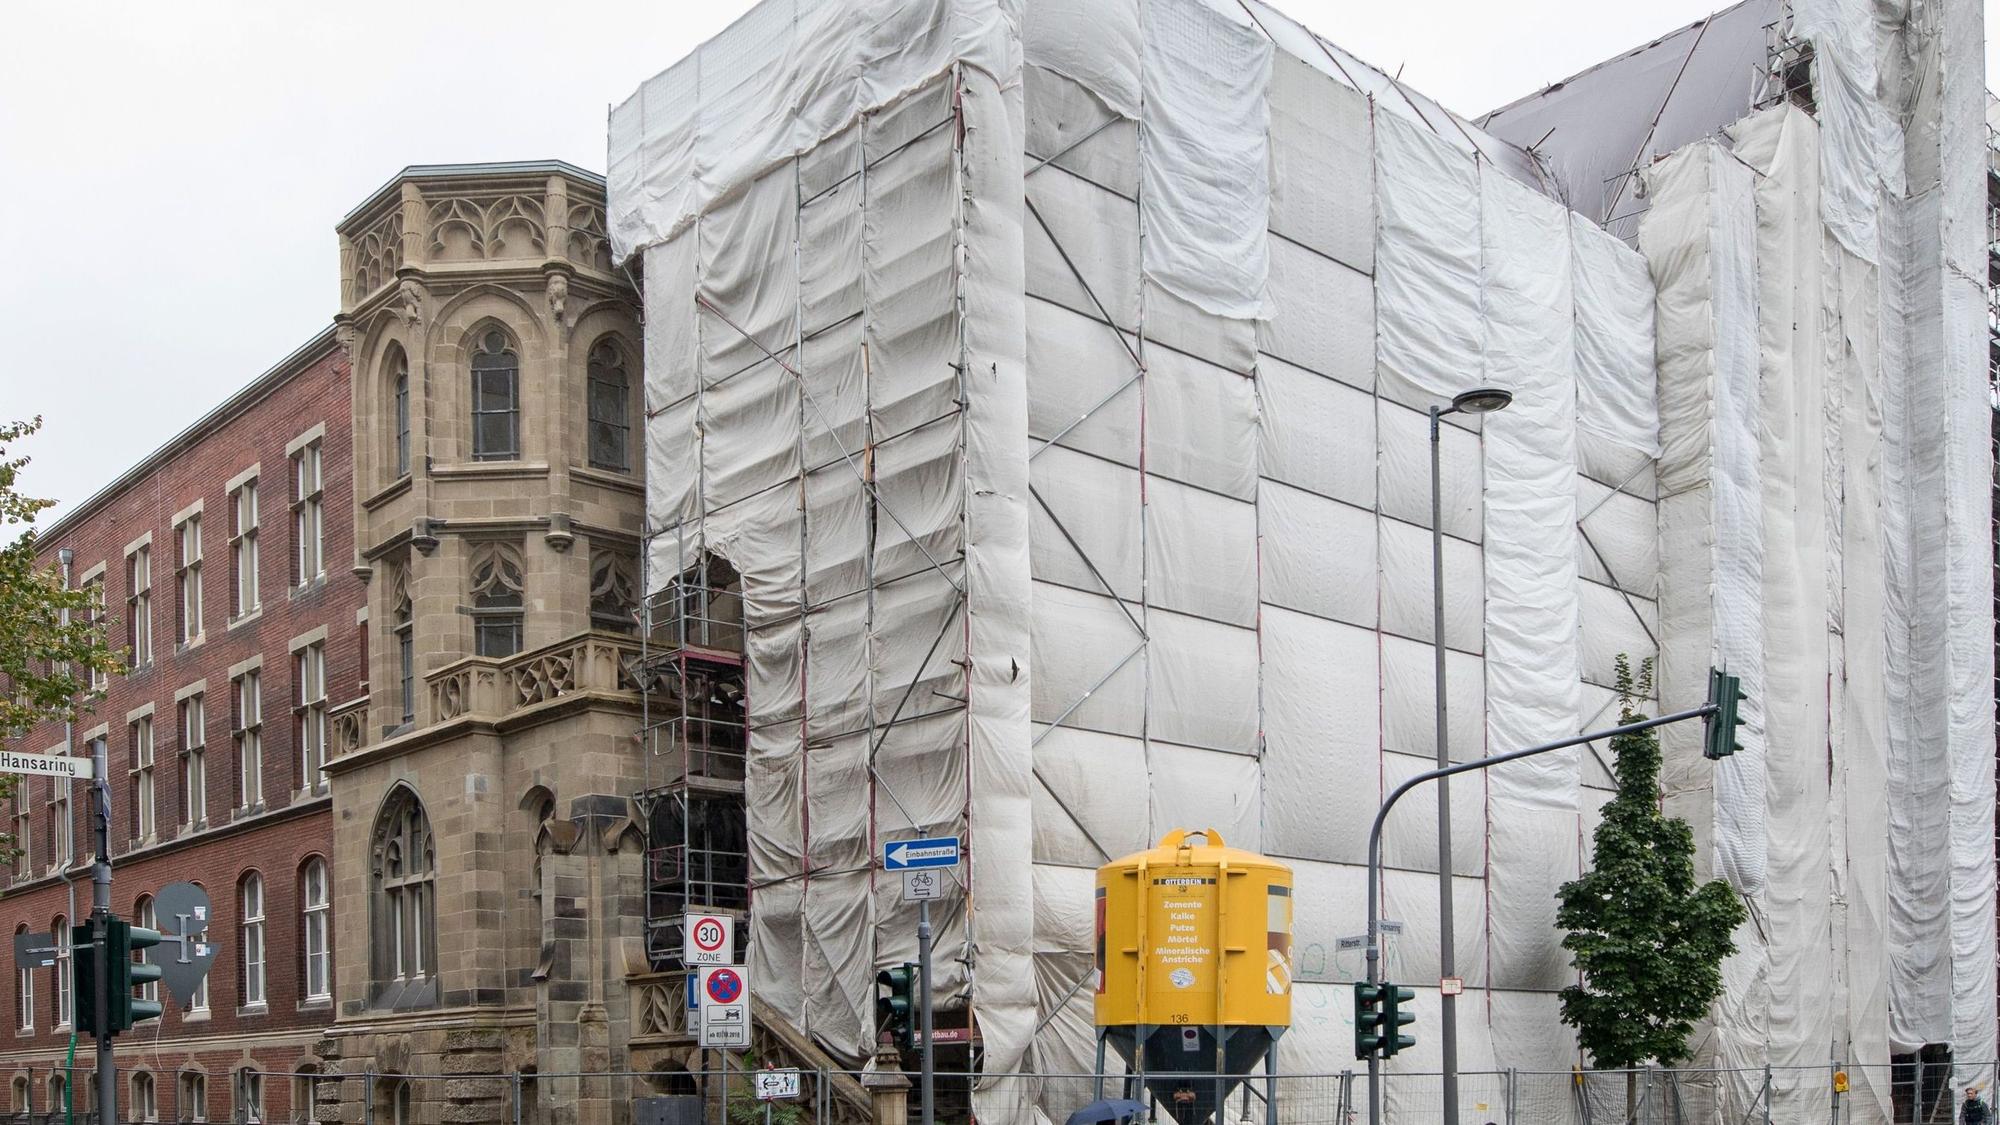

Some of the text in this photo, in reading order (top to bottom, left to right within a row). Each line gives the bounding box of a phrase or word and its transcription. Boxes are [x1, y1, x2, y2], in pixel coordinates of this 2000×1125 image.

[1, 752, 76, 776] Hansaring
[905, 848, 955, 859] Einbahnstraße
[1165, 878, 1202, 886] OTTERBEIN
[1163, 901, 1202, 909] Zemente
[1170, 912, 1195, 920] Kalke
[1170, 924, 1195, 932] Putze
[700, 927, 719, 942] 30
[1168, 935, 1198, 943] Mörtel
[1155, 947, 1211, 955] Mineralische
[697, 952, 721, 962] ZONE
[1171, 1013, 1189, 1024] 136
